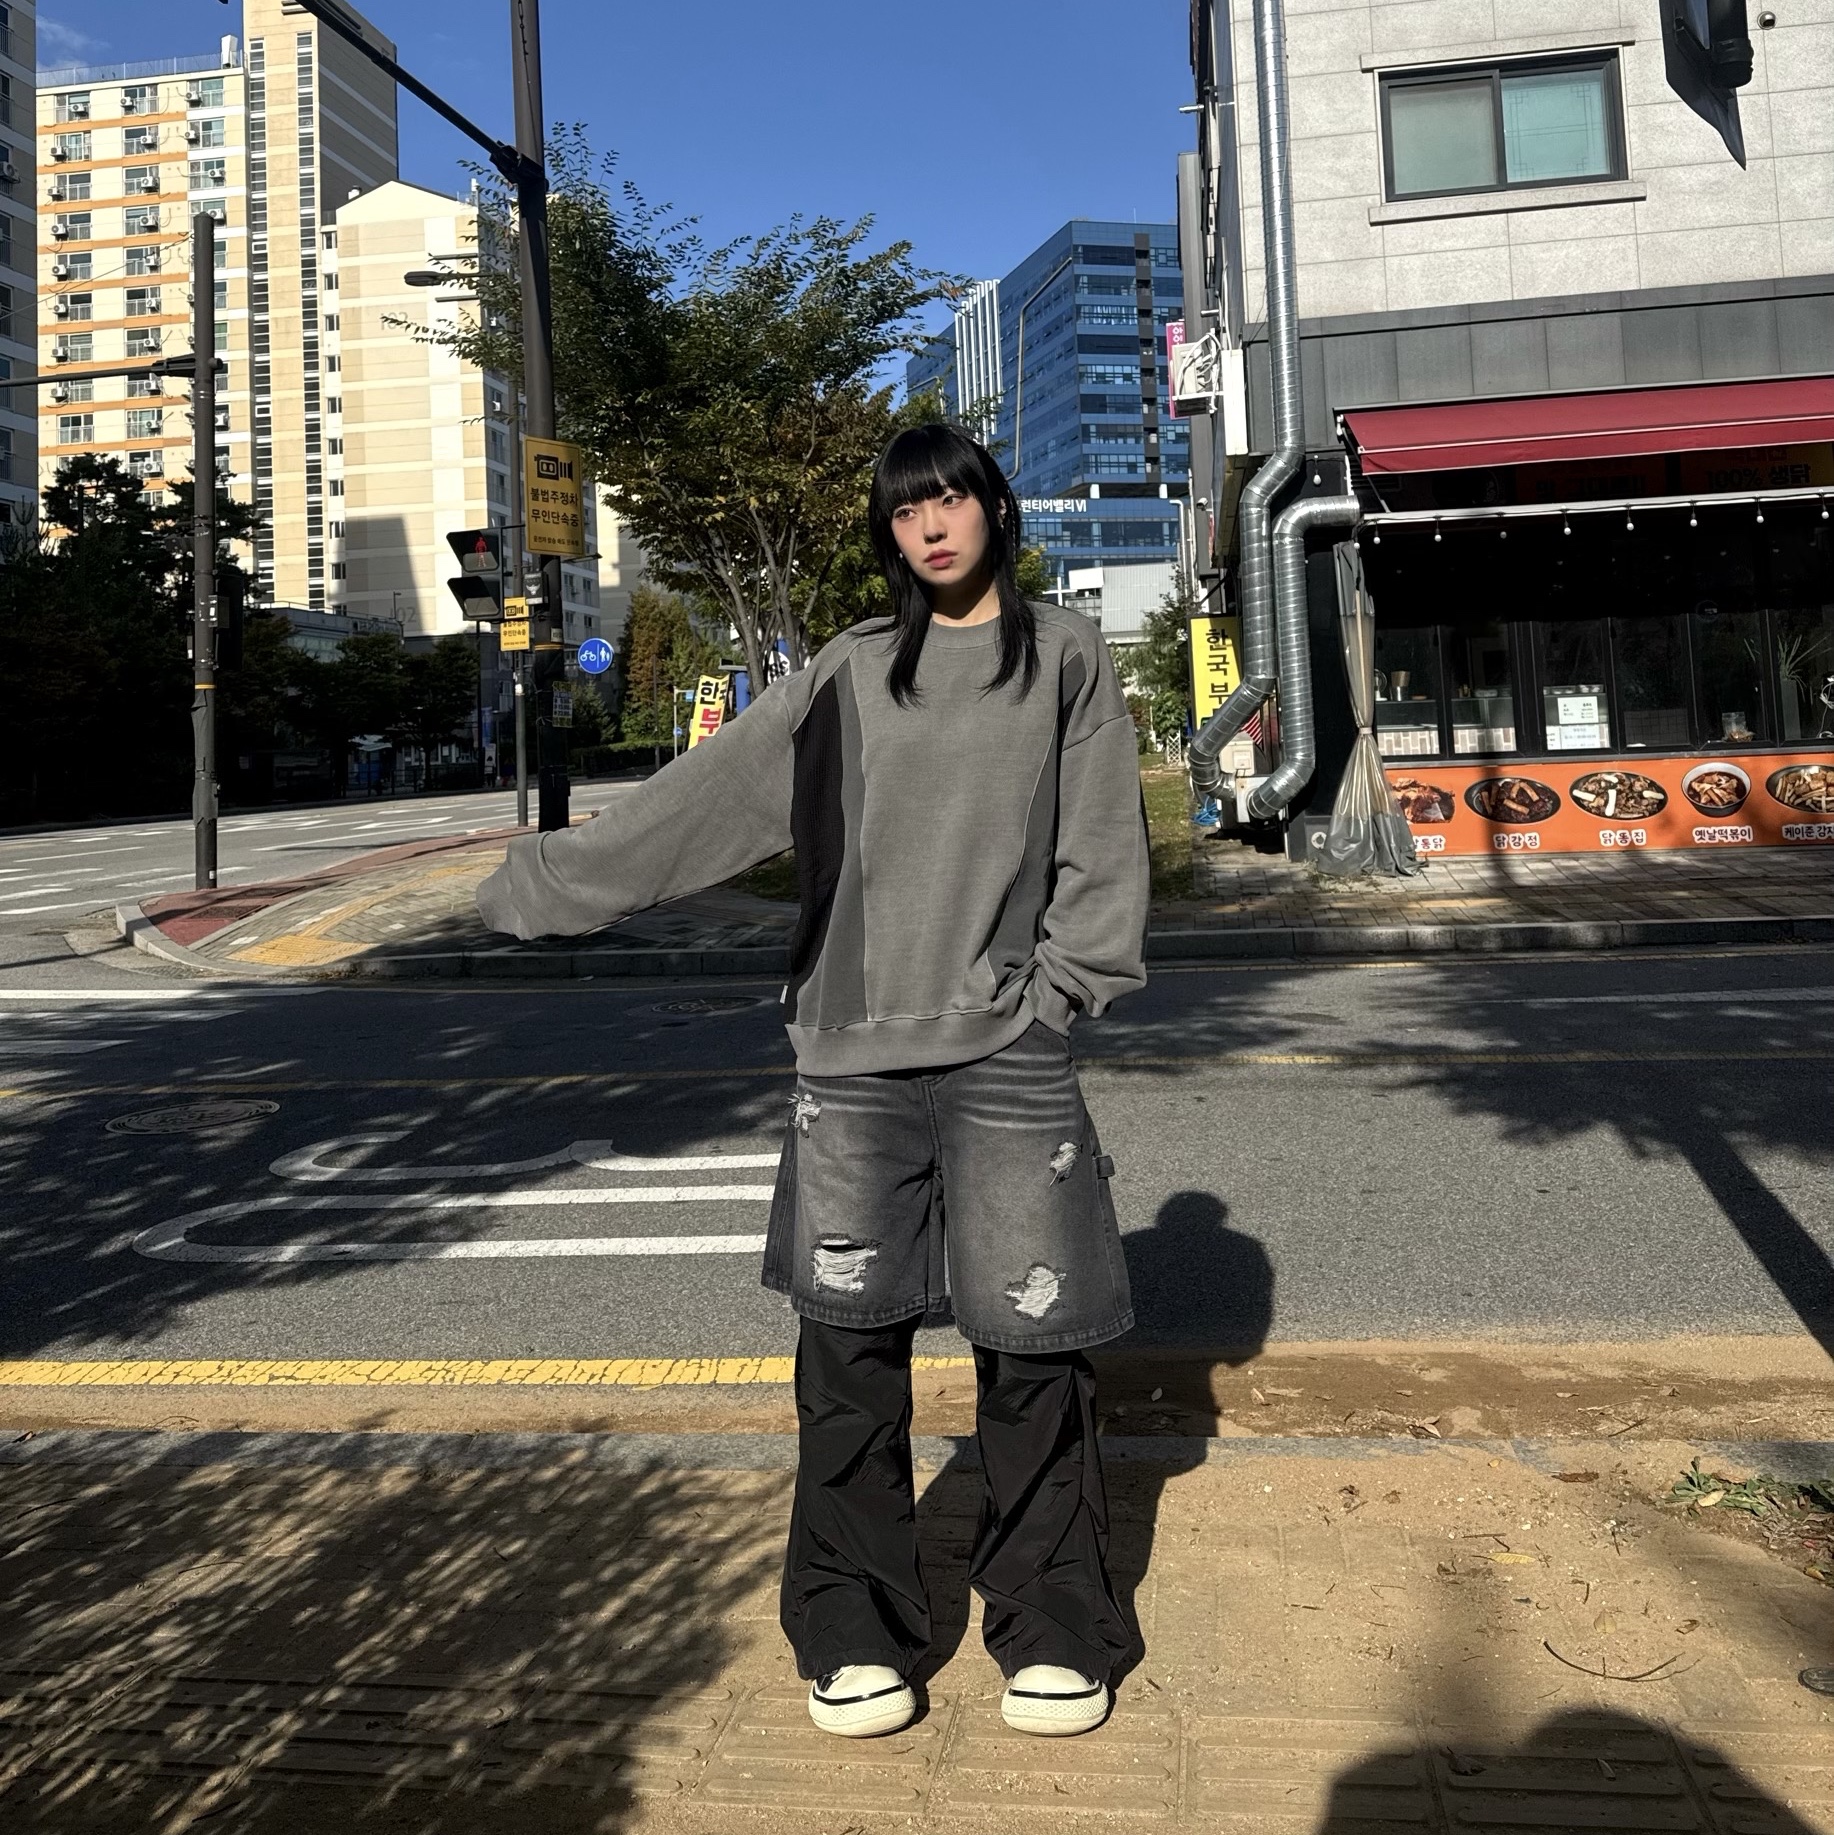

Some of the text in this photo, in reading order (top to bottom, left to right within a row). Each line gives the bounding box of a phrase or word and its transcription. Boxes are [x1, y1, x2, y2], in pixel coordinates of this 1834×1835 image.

[1172, 326, 1184, 345] 아이
[530, 487, 579, 507] 불법주정차
[1017, 499, 1087, 513] 런티어밸리VI
[531, 508, 579, 527] 무인단속중
[1206, 628, 1231, 714] 한국부
[1494, 833, 1538, 848] 닭강정
[1694, 827, 1752, 841] 옛날떡볶이
